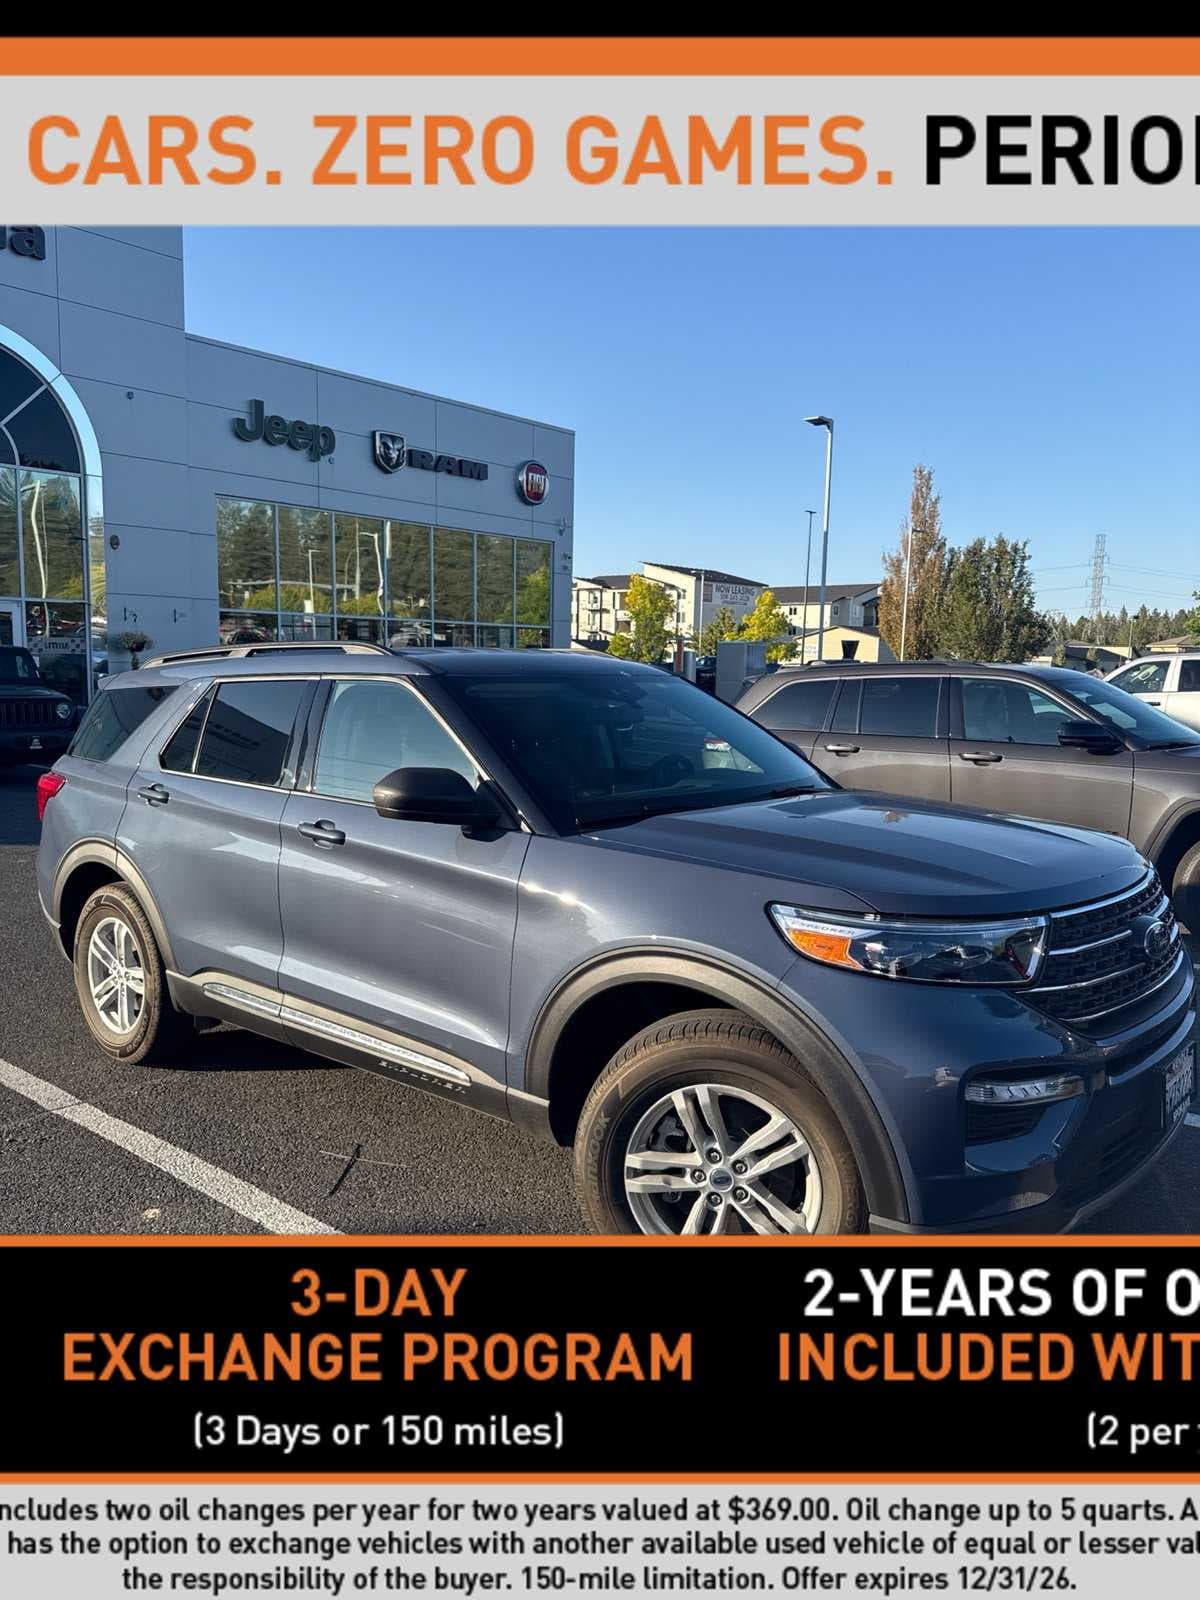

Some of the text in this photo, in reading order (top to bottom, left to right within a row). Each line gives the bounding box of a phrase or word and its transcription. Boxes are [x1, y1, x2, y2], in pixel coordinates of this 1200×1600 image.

[230, 399, 336, 462] Jeep
[407, 448, 489, 481] RAM
[715, 583, 731, 595] NOW
